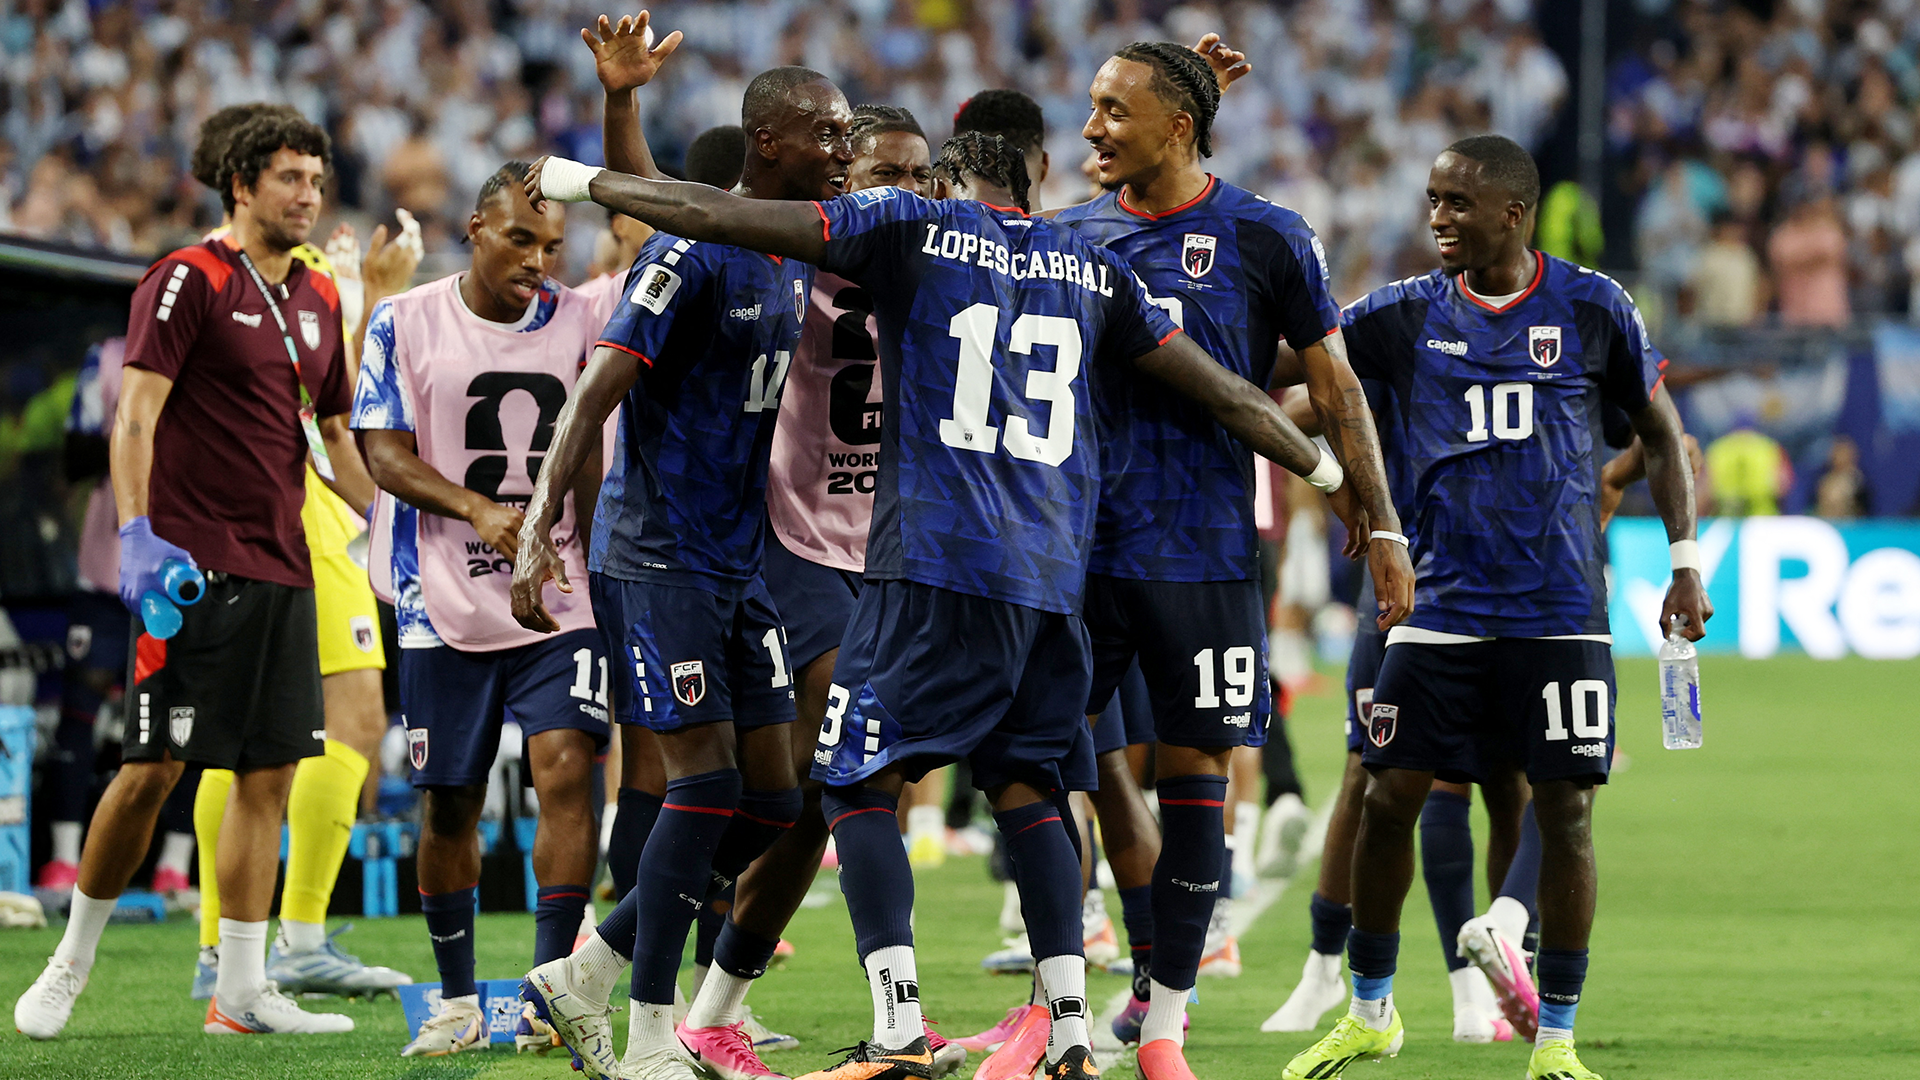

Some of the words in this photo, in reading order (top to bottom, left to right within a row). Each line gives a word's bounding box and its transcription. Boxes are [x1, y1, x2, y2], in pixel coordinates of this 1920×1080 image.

[1186, 236, 1214, 244] FCF
[922, 223, 1009, 276] LOPES
[1011, 250, 1114, 298] CABRAL
[1426, 339, 1469, 354] capelli
[938, 302, 1083, 468] 13
[862, 410, 881, 429] FI
[1464, 381, 1534, 443] 10
[827, 470, 878, 495] 20
[467, 558, 515, 578] 20
[673, 663, 700, 673] FCF
[761, 626, 794, 689] 1
[569, 647, 609, 709] 11
[1193, 646, 1255, 709] 19
[1374, 705, 1397, 713] FCF
[1542, 679, 1609, 741] 10
[814, 748, 833, 763] pelli
[883, 984, 896, 1030] TAPEDESIGN
